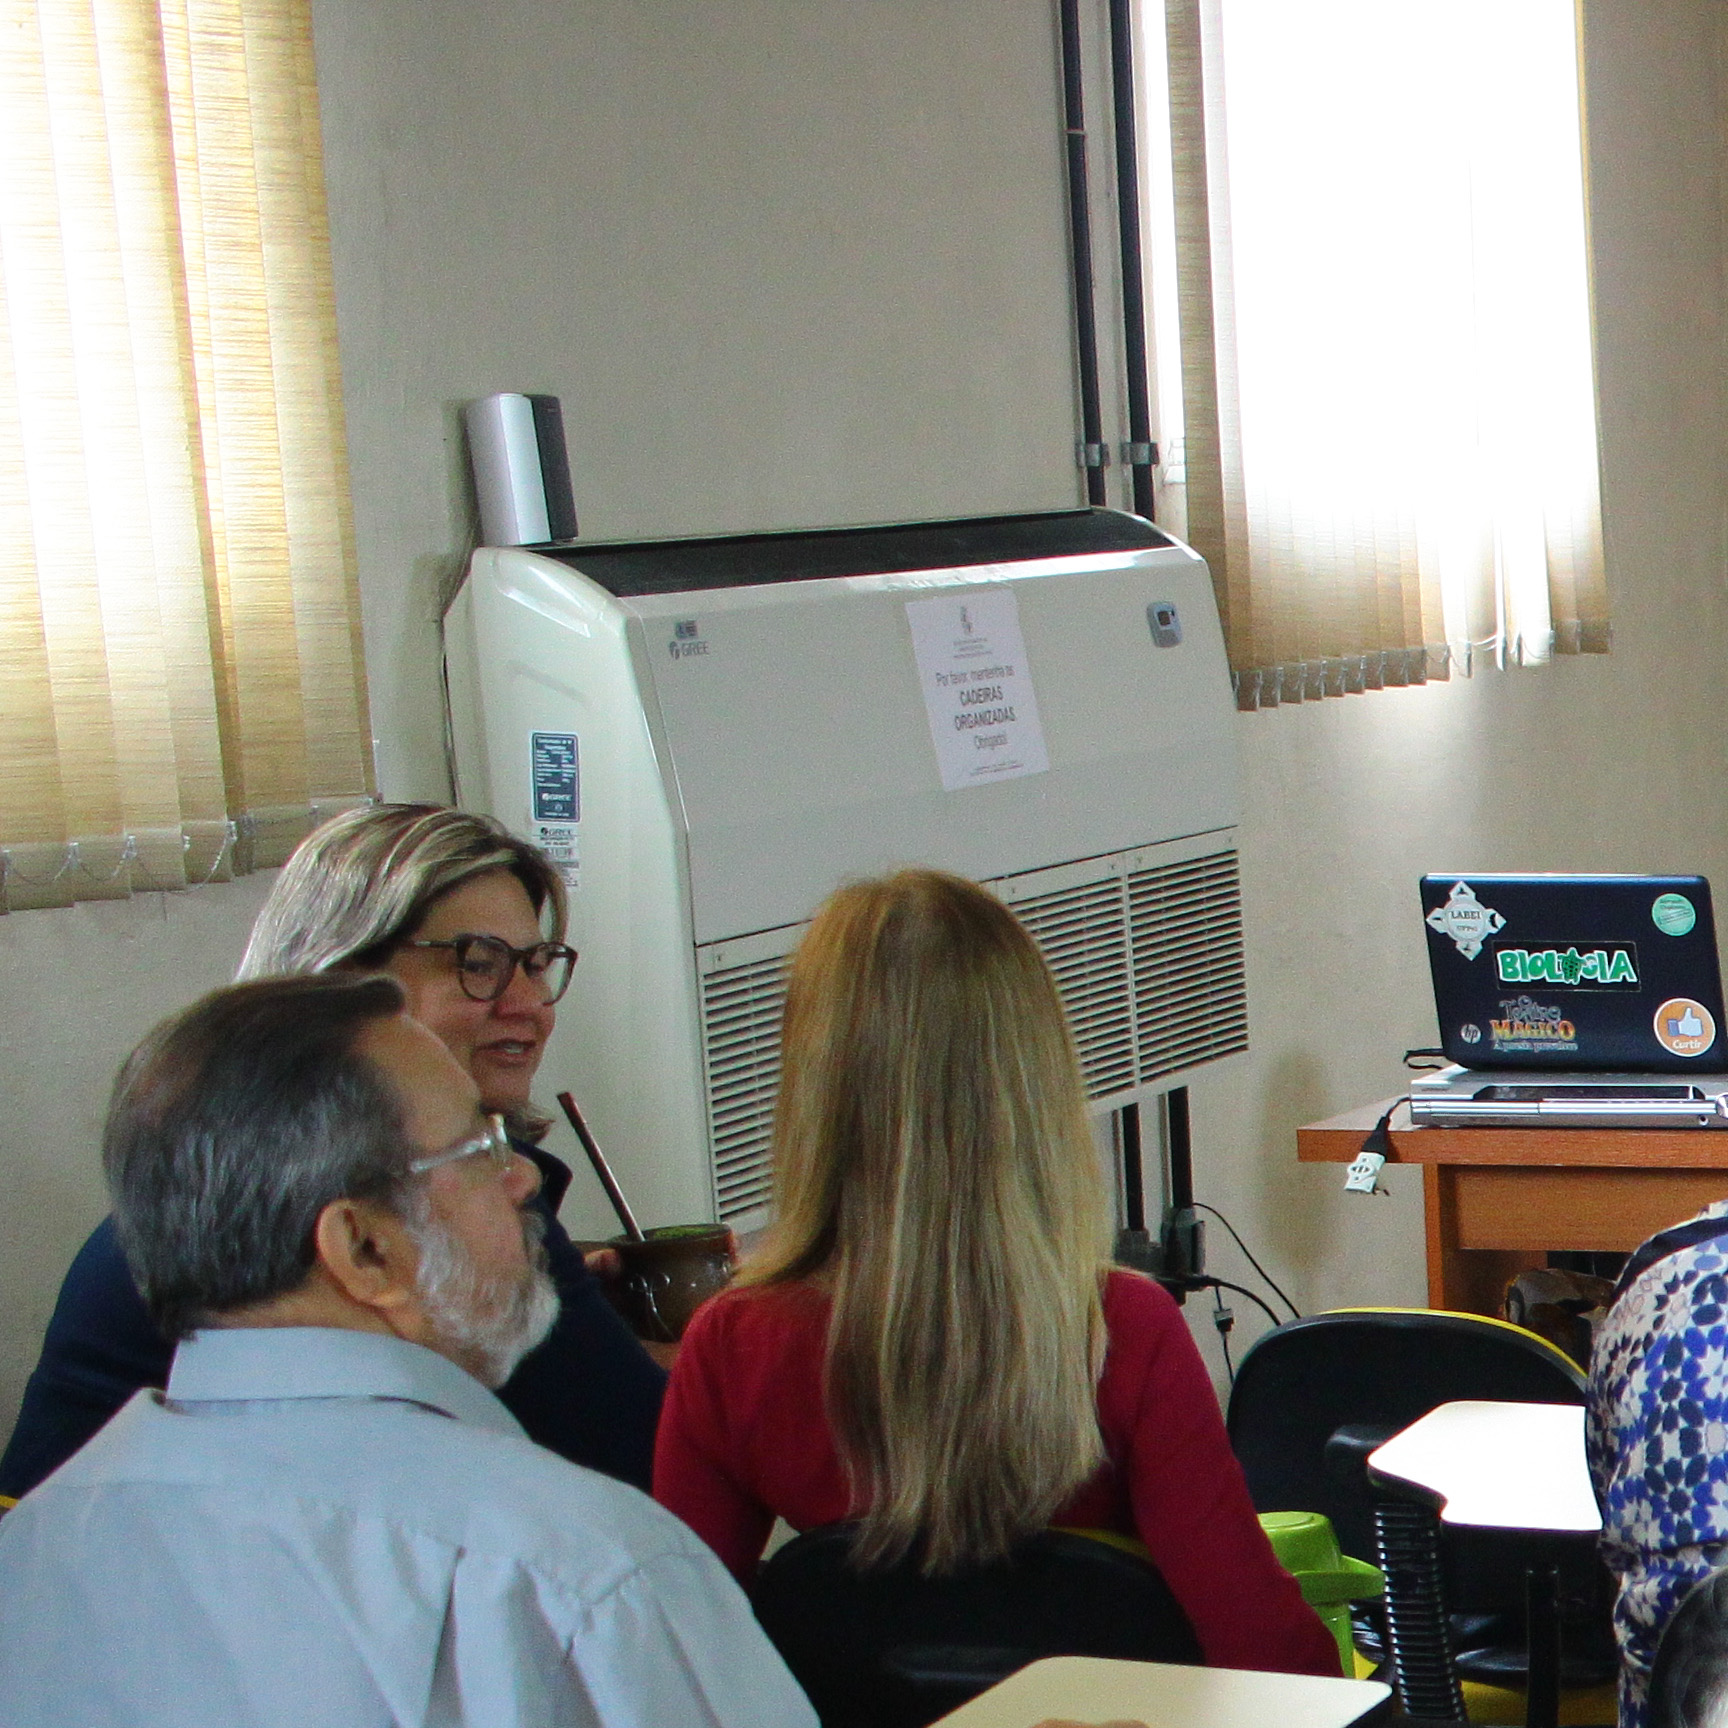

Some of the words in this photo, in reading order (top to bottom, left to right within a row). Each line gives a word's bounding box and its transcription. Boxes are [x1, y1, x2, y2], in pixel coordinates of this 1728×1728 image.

[959, 685, 1003, 706] CADEIRAS
[954, 706, 1017, 731] ORGANIZADAS
[1673, 1040, 1702, 1050] Curtir
